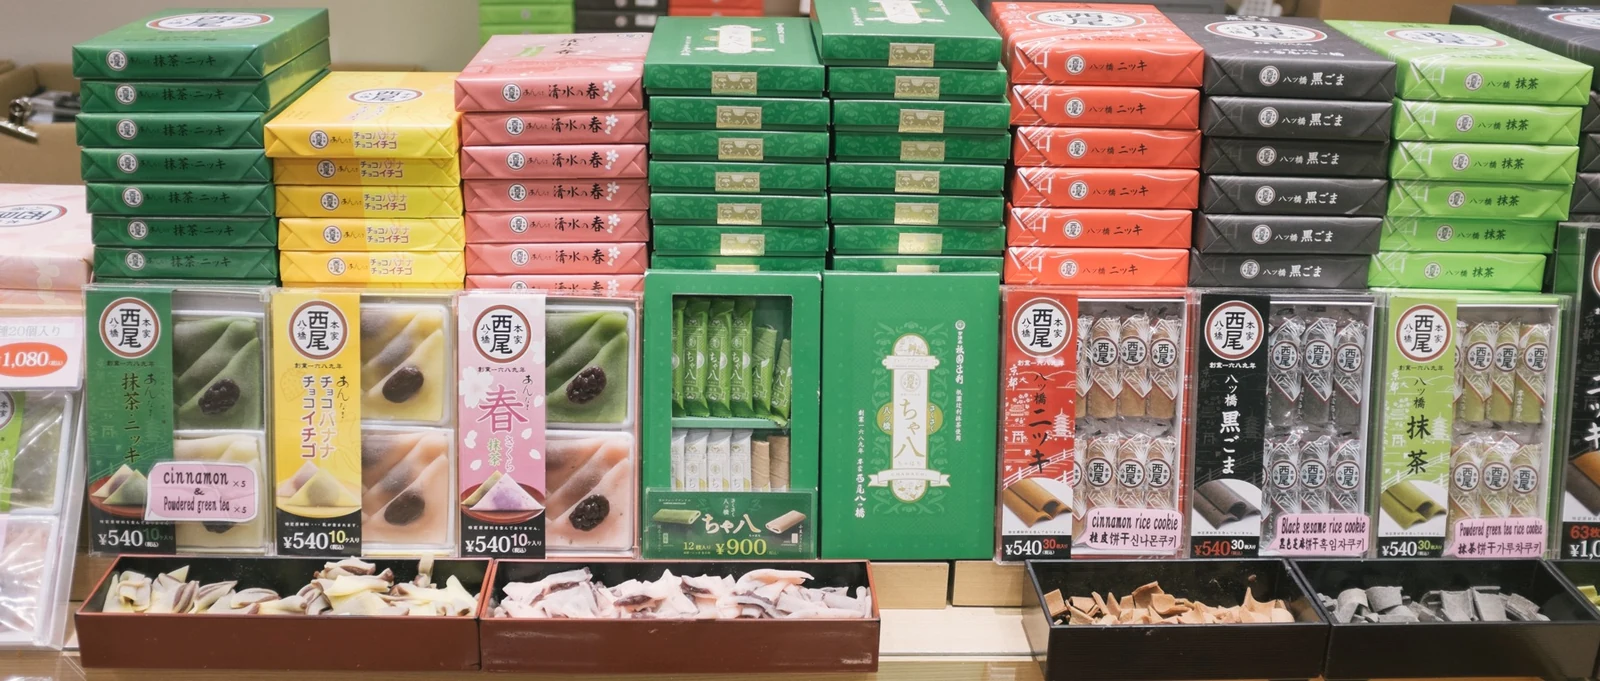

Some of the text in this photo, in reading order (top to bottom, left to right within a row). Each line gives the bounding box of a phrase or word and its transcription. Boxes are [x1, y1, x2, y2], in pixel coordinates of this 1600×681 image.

[1118, 60, 1147, 71] ニッキ
[1311, 72, 1345, 86] 黒ごま
[1515, 77, 1539, 90] 抹茶
[548, 82, 600, 99] 清水の春
[1117, 104, 1146, 114] ニッキ
[551, 116, 603, 133] 清水の春
[1309, 113, 1343, 126] 黒ごま
[1506, 119, 1529, 131] 抹茶
[354, 141, 397, 149] チョコイチゴ
[1118, 143, 1147, 154] ニッキ
[552, 152, 604, 168] 清水の春
[1306, 152, 1340, 165] 黒ごま
[1502, 158, 1524, 170] 抹茶
[361, 170, 403, 178] チョコイチゴ
[553, 183, 604, 199] 清水の春
[1120, 185, 1148, 196] ニッキ
[1305, 191, 1338, 204] 黒ごま
[364, 202, 407, 211] チョコイチゴ
[1497, 195, 1520, 206] 抹茶
[555, 216, 605, 232] 清水の春
[1114, 225, 1143, 235] ニッキ
[367, 235, 409, 244] チョコイチゴ
[1301, 230, 1334, 242] 黒ごま
[1484, 229, 1506, 240] 抹茶
[555, 248, 605, 264] 清水の春
[371, 267, 413, 275] チョコイチゴ
[1110, 264, 1138, 275] ニッキ
[1289, 265, 1322, 278] 黒ごま
[1472, 267, 1494, 278] 抹茶
[118, 308, 141, 348] 西尾
[142, 318, 152, 338] 本家
[306, 311, 329, 350] 西尾
[330, 321, 340, 341] 本家
[490, 315, 513, 354] 西尾
[514, 324, 523, 344] 本家
[1030, 309, 1053, 348] 西尾
[1054, 318, 1063, 338] 本家
[1222, 312, 1246, 349] 西尾
[1246, 322, 1255, 340] 本家
[1411, 315, 1434, 353] 西尾
[1434, 324, 1443, 343] 本家
[1097, 342, 1109, 363] 西尾
[1126, 342, 1138, 363] 西尾
[1157, 344, 1169, 364] 西尾
[1279, 346, 1291, 366] 西尾
[1312, 345, 1325, 366] 西尾
[1344, 349, 1356, 369] 西尾
[1475, 347, 1487, 367] 西尾
[1501, 348, 1514, 368] 西尾
[1532, 348, 1545, 368] 西尾
[302, 376, 316, 457] チョコイチゴ
[320, 376, 336, 458] チョコバナナ
[478, 385, 528, 432] 春
[894, 399, 925, 458] ちゃ八
[1029, 409, 1052, 473] ニッキ
[1220, 411, 1241, 474] 黒ごま
[1407, 415, 1431, 475] 抹茶
[487, 438, 501, 467] 抹茶
[164, 468, 228, 484] cinnamon
[1092, 463, 1104, 483] 西尾
[1125, 464, 1136, 484] 西尾
[1151, 464, 1163, 484] 西尾
[1278, 465, 1290, 486] 西尾
[1308, 465, 1319, 485] 西尾
[1342, 466, 1354, 487] 西尾
[1461, 468, 1472, 488] 西尾
[1490, 467, 1502, 487] 西尾
[1518, 470, 1530, 490] 西尾
[164, 496, 194, 511] Powdered
[198, 500, 217, 513] green
[220, 497, 230, 511] tea
[702, 513, 762, 534] ちゃ八
[1092, 511, 1178, 530] cinnamon rice cookie
[1282, 517, 1366, 534] Black sesame rice cookie
[1460, 522, 1484, 536] Powdered
[1486, 525, 1501, 538] green
[1514, 521, 1524, 535] rice
[1526, 520, 1542, 534] cookie
[98, 530, 143, 546] ¥540
[283, 532, 329, 550] ¥540
[465, 536, 510, 553] ¥540
[715, 538, 766, 555] ¥900
[1005, 540, 1042, 555] ¥540
[1194, 541, 1231, 556] ¥540
[1382, 541, 1417, 556] ¥540
